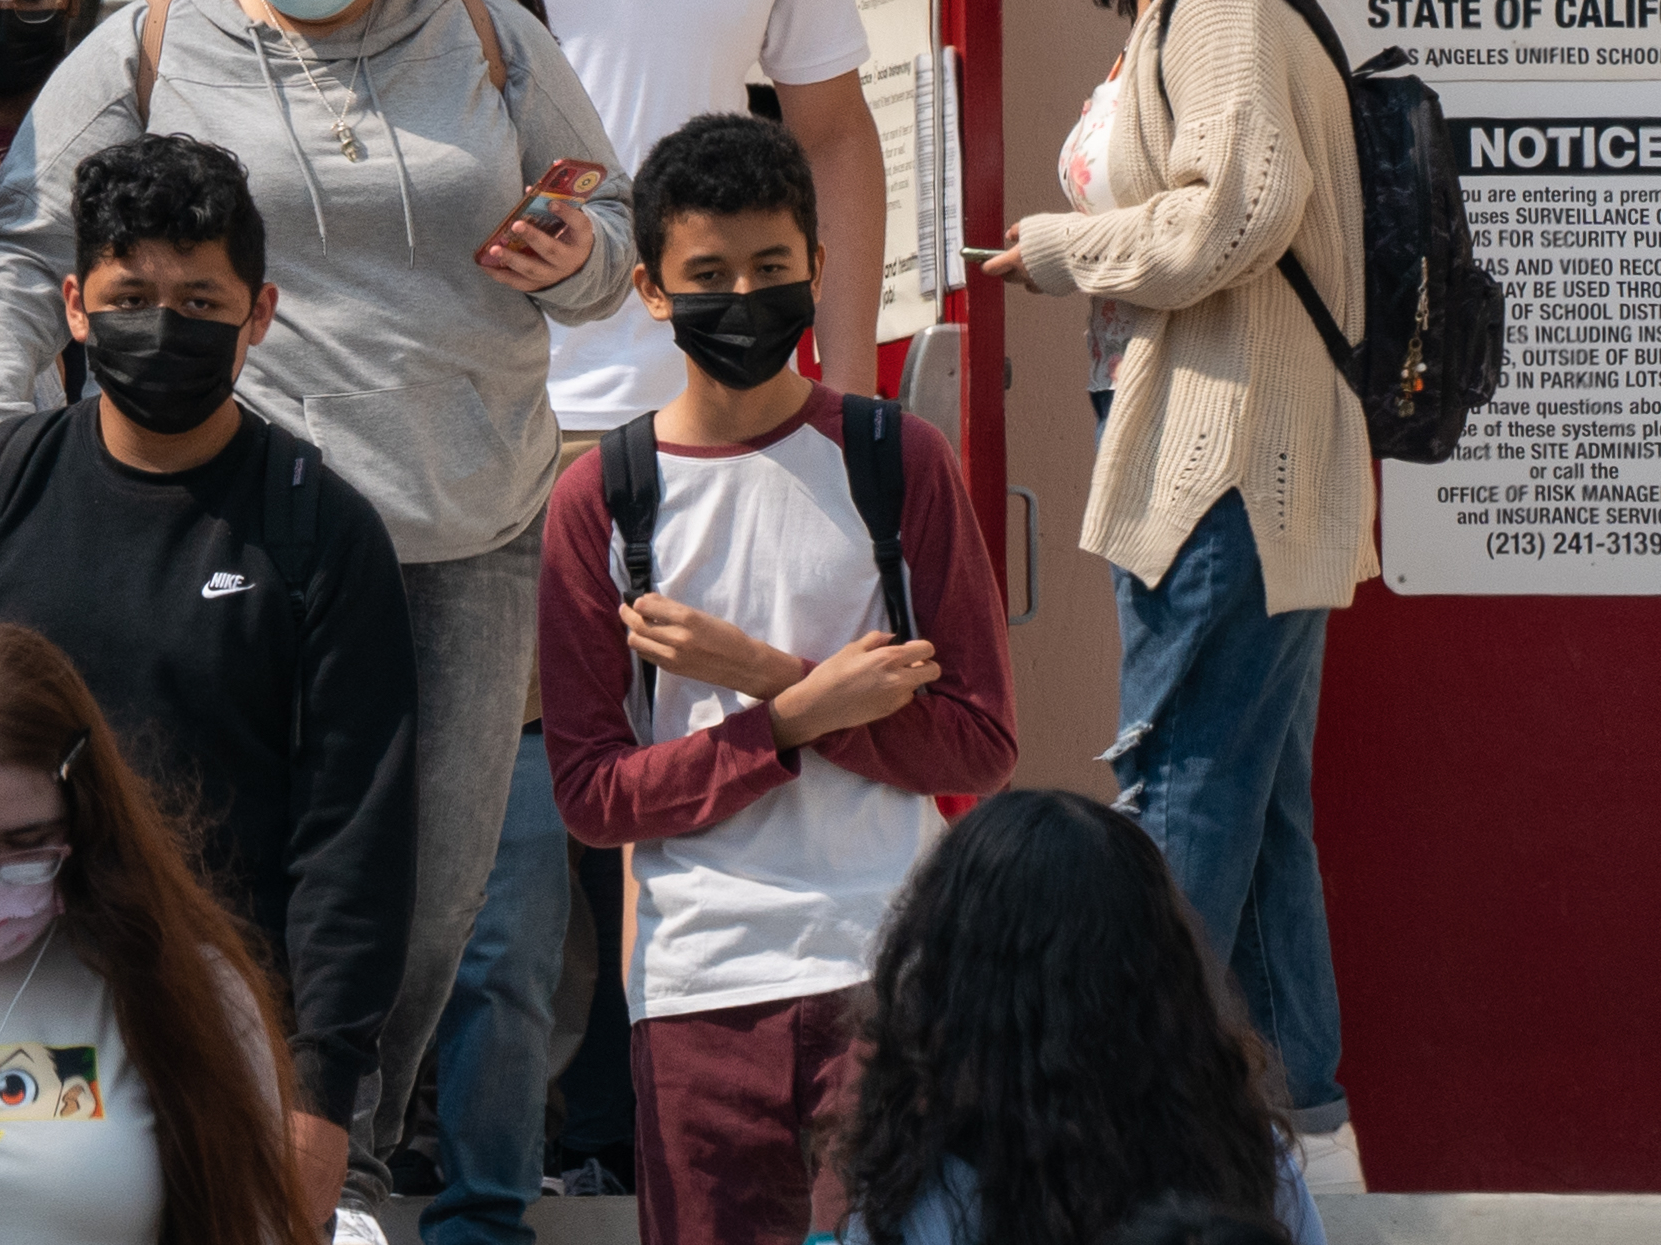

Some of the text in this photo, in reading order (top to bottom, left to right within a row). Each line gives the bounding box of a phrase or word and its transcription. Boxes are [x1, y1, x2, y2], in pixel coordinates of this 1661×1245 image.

[1425, 47, 1509, 65] ANGELES
[1516, 47, 1590, 65] UNIFIED
[1596, 47, 1661, 65] SCHOO
[1470, 126, 1661, 168] NOTICE
[1461, 189, 1481, 203] ou
[1488, 189, 1516, 203] are
[1522, 186, 1597, 207] entering
[1603, 189, 1613, 203] a
[1468, 211, 1509, 224] uses
[1516, 208, 1650, 225] SURVEILLANCE
[1499, 231, 1534, 247] FOR
[1541, 231, 1627, 247] SECURITY
[1634, 231, 1661, 247] PU
[1515, 259, 1553, 276] AND
[1560, 259, 1613, 276] VIDEO
[1501, 281, 1527, 298] AY
[1533, 281, 1556, 298] BE
[1563, 281, 1610, 298] USED
[1511, 303, 1661, 320] OF SCHOOL DIST
[1535, 326, 1632, 343] INCLUDING
[1522, 349, 1600, 366] OUTSIDE
[1605, 348, 1629, 366] OF
[1635, 348, 1661, 365] BU
[1516, 372, 1534, 389] IN
[1540, 371, 1619, 389] PARKING
[1626, 371, 1661, 388] LOT
[1488, 400, 1530, 415] have
[1536, 399, 1623, 419] questions
[1484, 420, 1502, 437] of
[1508, 421, 1555, 437] these
[1562, 421, 1636, 441] systems
[1643, 421, 1661, 440] pl
[1497, 443, 1525, 460] the
[1531, 443, 1569, 460] SITE
[1530, 463, 1619, 479] or call the
[1438, 485, 1661, 503] OFFICE OF RISK MANAGE
[1457, 507, 1661, 525] and INSURANCE SERVI
[1487, 532, 1661, 560] (213) 241-3139
[209, 572, 245, 589] NIKE
